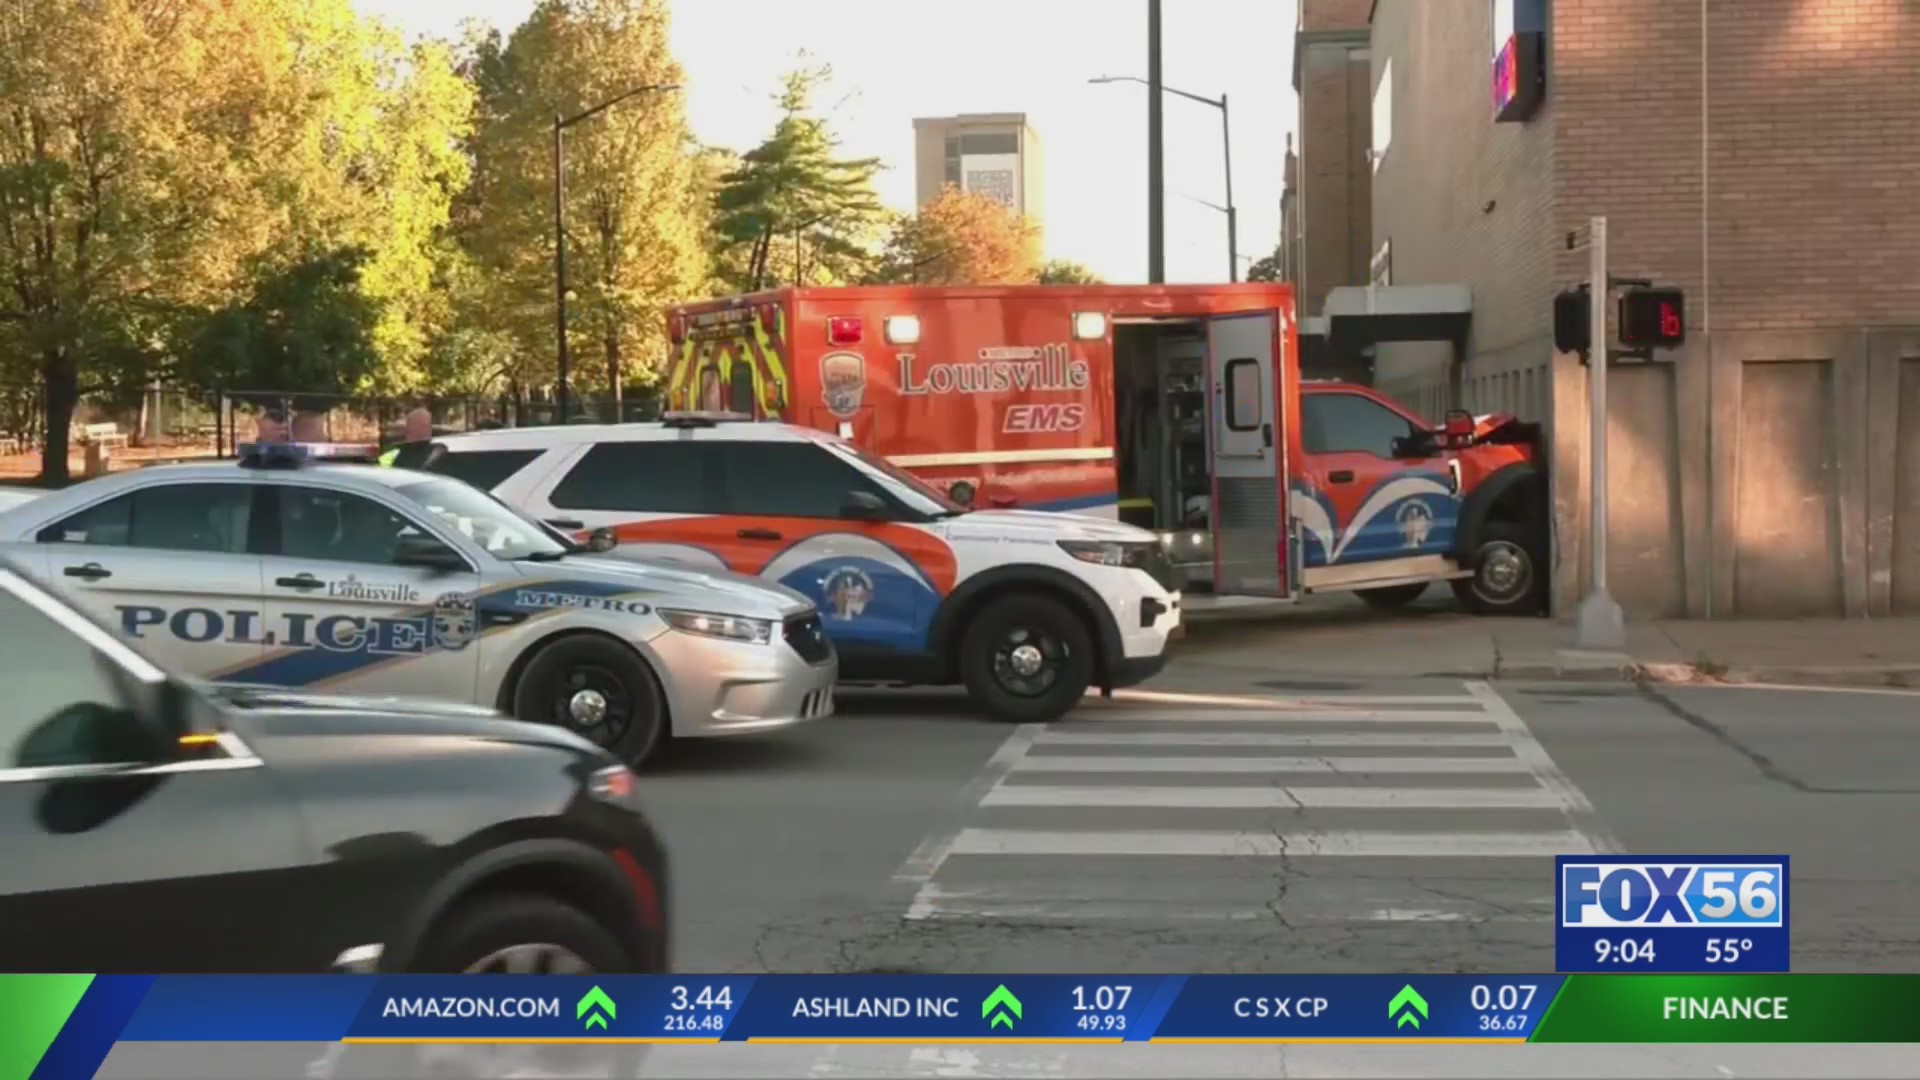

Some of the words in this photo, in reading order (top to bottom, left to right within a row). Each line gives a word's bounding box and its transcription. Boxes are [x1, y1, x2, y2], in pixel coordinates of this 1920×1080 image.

[897, 343, 1089, 394] Louisville
[1003, 404, 1085, 433] EMS
[328, 581, 419, 601] Louisville
[515, 590, 652, 616] METRO
[116, 605, 428, 654] POLICE
